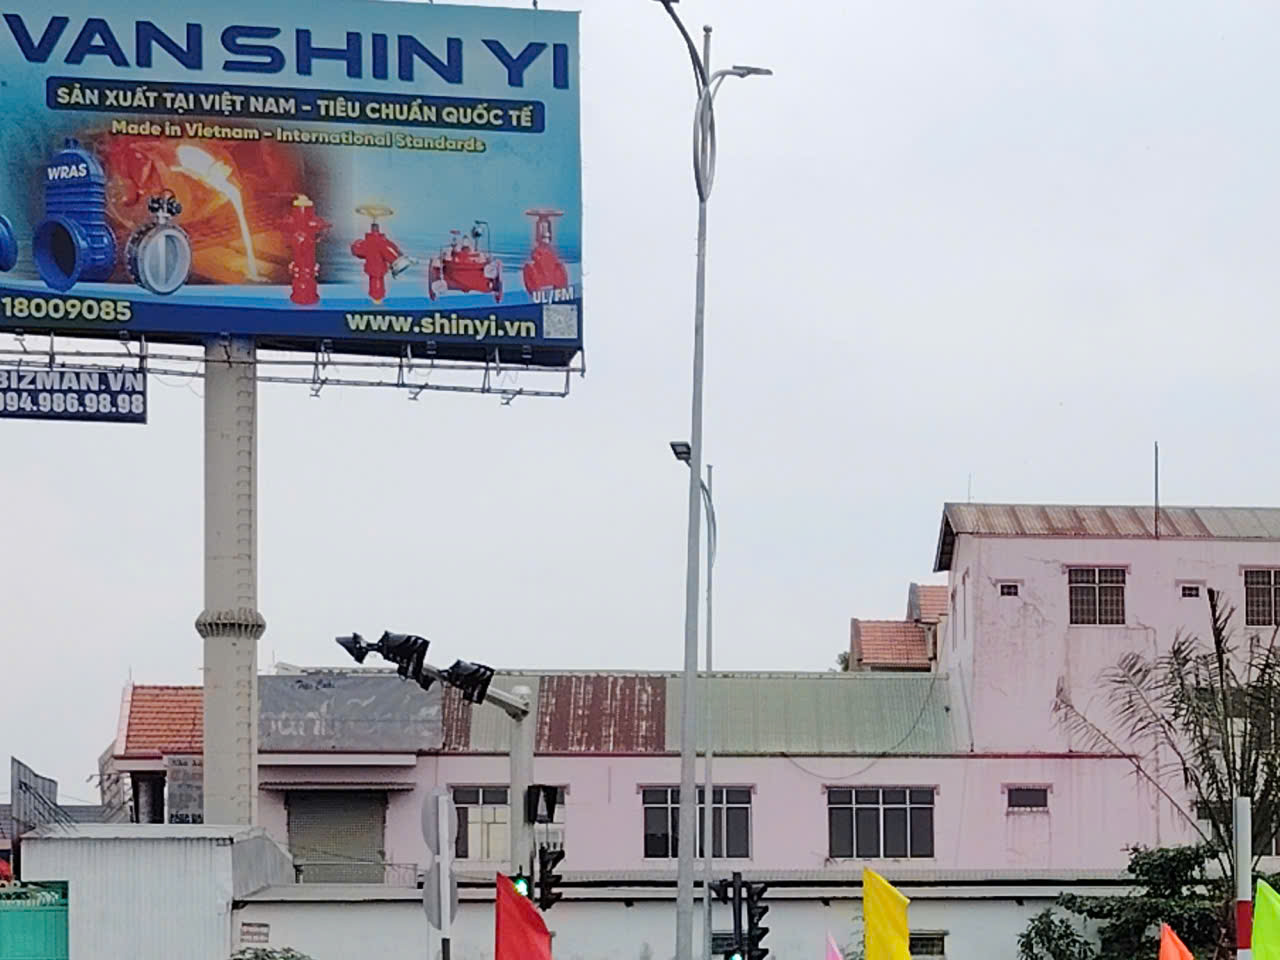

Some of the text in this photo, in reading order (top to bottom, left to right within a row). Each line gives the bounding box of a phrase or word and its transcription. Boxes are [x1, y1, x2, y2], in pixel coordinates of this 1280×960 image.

[57, 83, 99, 105] SẢN
[105, 86, 158, 108] XUẤT
[162, 92, 194, 114] TẠI
[199, 91, 245, 115] VIỆT
[249, 95, 296, 114] NAM
[317, 97, 360, 119] TIÊU
[442, 103, 503, 125] QUỐC
[508, 106, 533, 127] TẾ
[112, 120, 162, 135] Made
[165, 121, 181, 136] in
[185, 122, 260, 139] Vietnam
[276, 127, 391, 147] International
[396, 134, 486, 151] Standards
[48, 163, 88, 180] WRAS
[532, 287, 574, 304] UL/FM
[1, 297, 132, 321] 18009085
[346, 312, 536, 340] www.shinyi.vn
